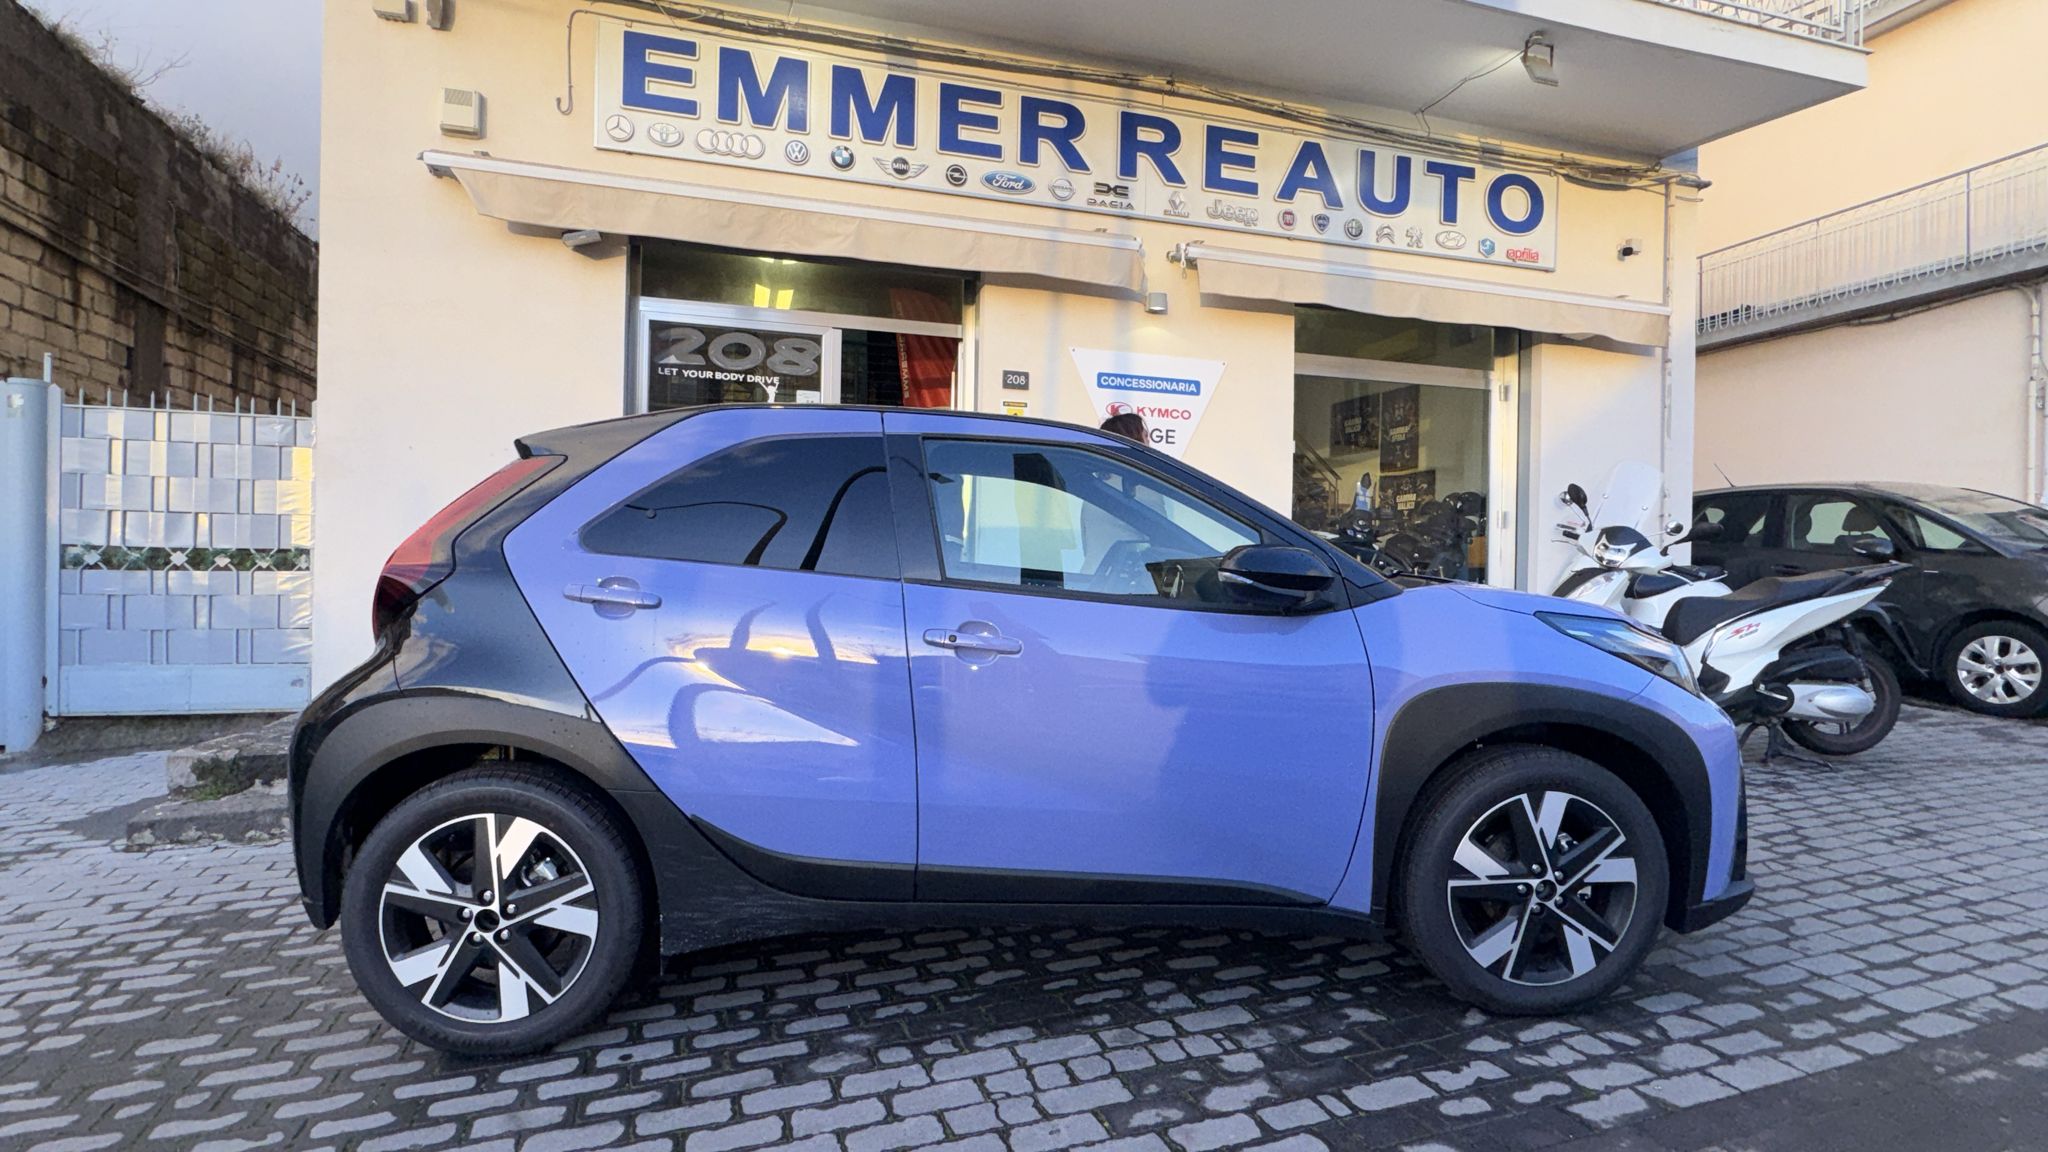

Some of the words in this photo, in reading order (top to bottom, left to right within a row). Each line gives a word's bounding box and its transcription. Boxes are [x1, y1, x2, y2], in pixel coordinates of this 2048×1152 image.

[621, 29, 1545, 235] EMMERREAUTO
[892, 162, 909, 170] MINI
[992, 173, 1024, 190] Ford
[1087, 198, 1135, 211] DACIA
[1206, 199, 1259, 227] Jeep
[656, 326, 822, 377] 208
[658, 367, 679, 376] LET
[682, 369, 713, 379] YOUR
[715, 371, 745, 382] BODY
[747, 375, 780, 385] DRIVE
[1006, 374, 1026, 385] 208
[1101, 376, 1197, 392] CONCESSIONARIA
[1136, 405, 1192, 420] KYMCO
